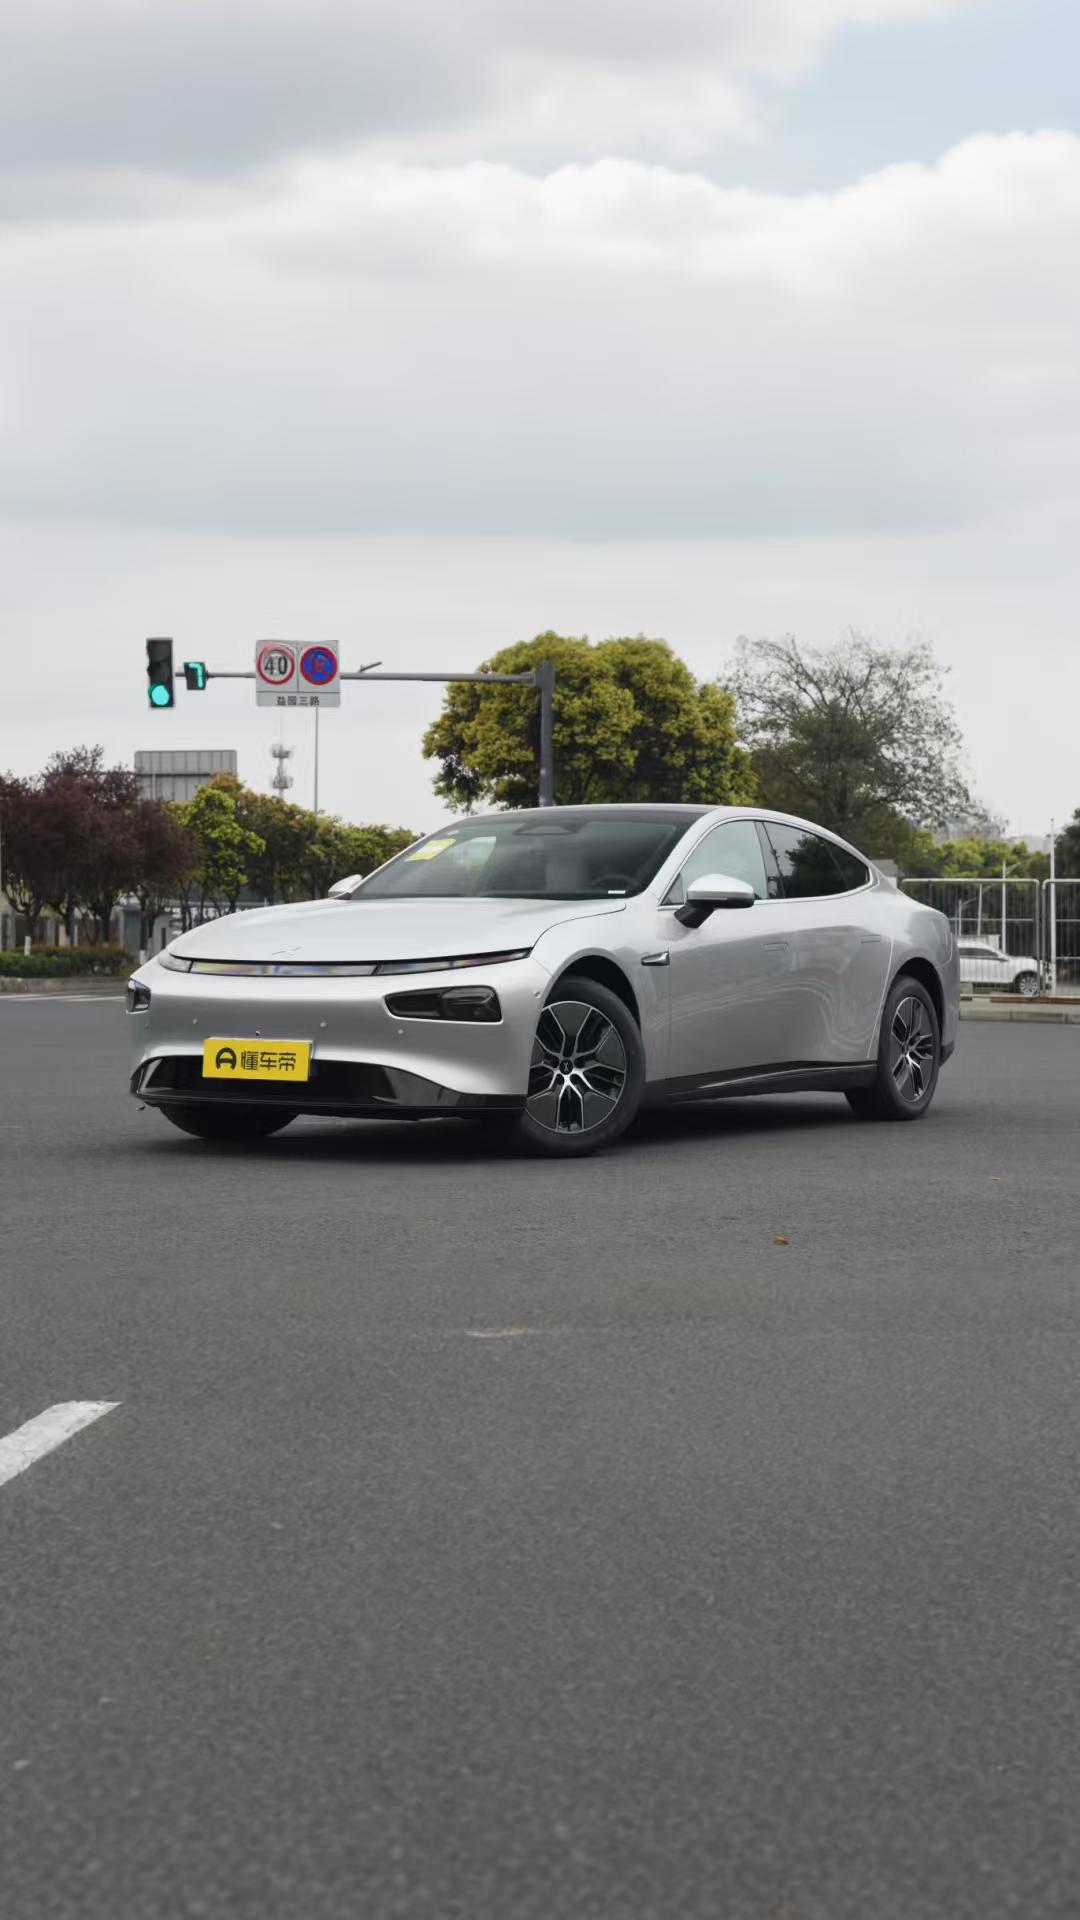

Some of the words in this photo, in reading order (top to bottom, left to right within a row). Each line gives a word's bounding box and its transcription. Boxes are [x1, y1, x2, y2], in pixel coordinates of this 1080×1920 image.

[264, 656, 288, 675] 40
[240, 1050, 297, 1071] 懂车帝
